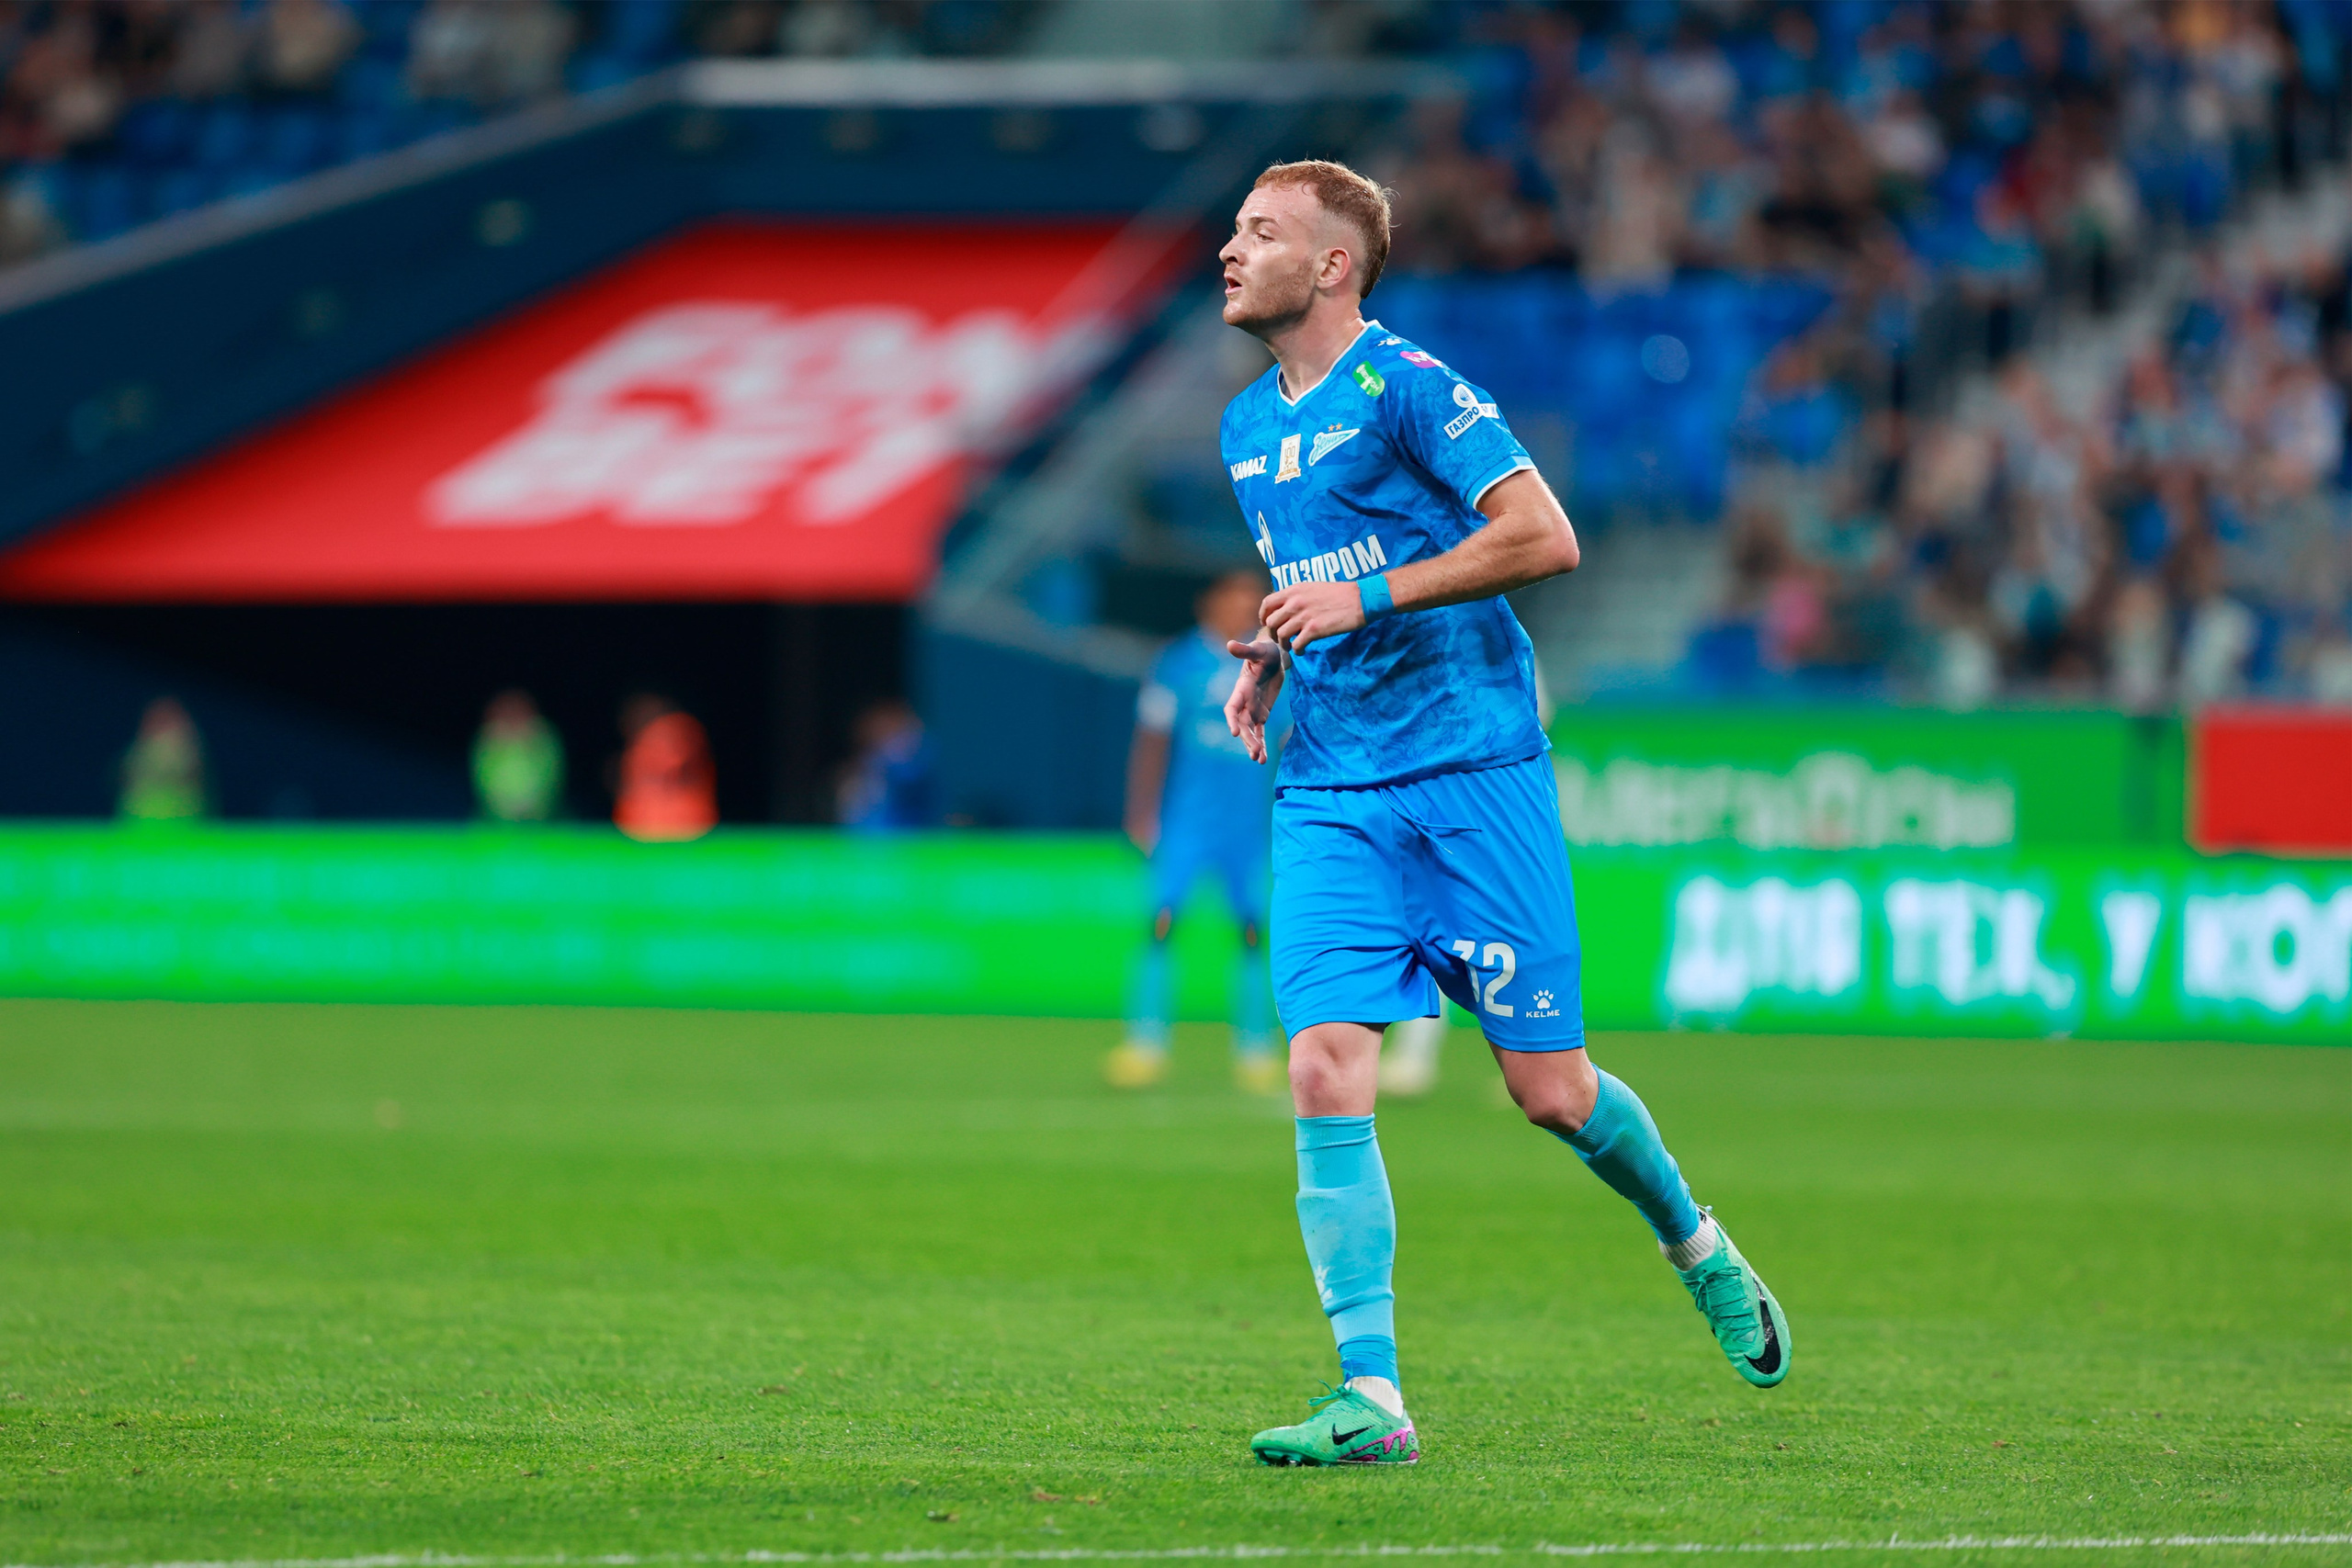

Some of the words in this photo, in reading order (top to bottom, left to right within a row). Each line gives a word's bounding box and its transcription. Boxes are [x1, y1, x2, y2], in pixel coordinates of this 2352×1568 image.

[1230, 455, 1268, 483] KAMAZ
[1281, 534, 1387, 590] ГАЗПРОМ
[1525, 1010, 1560, 1018] KELME
